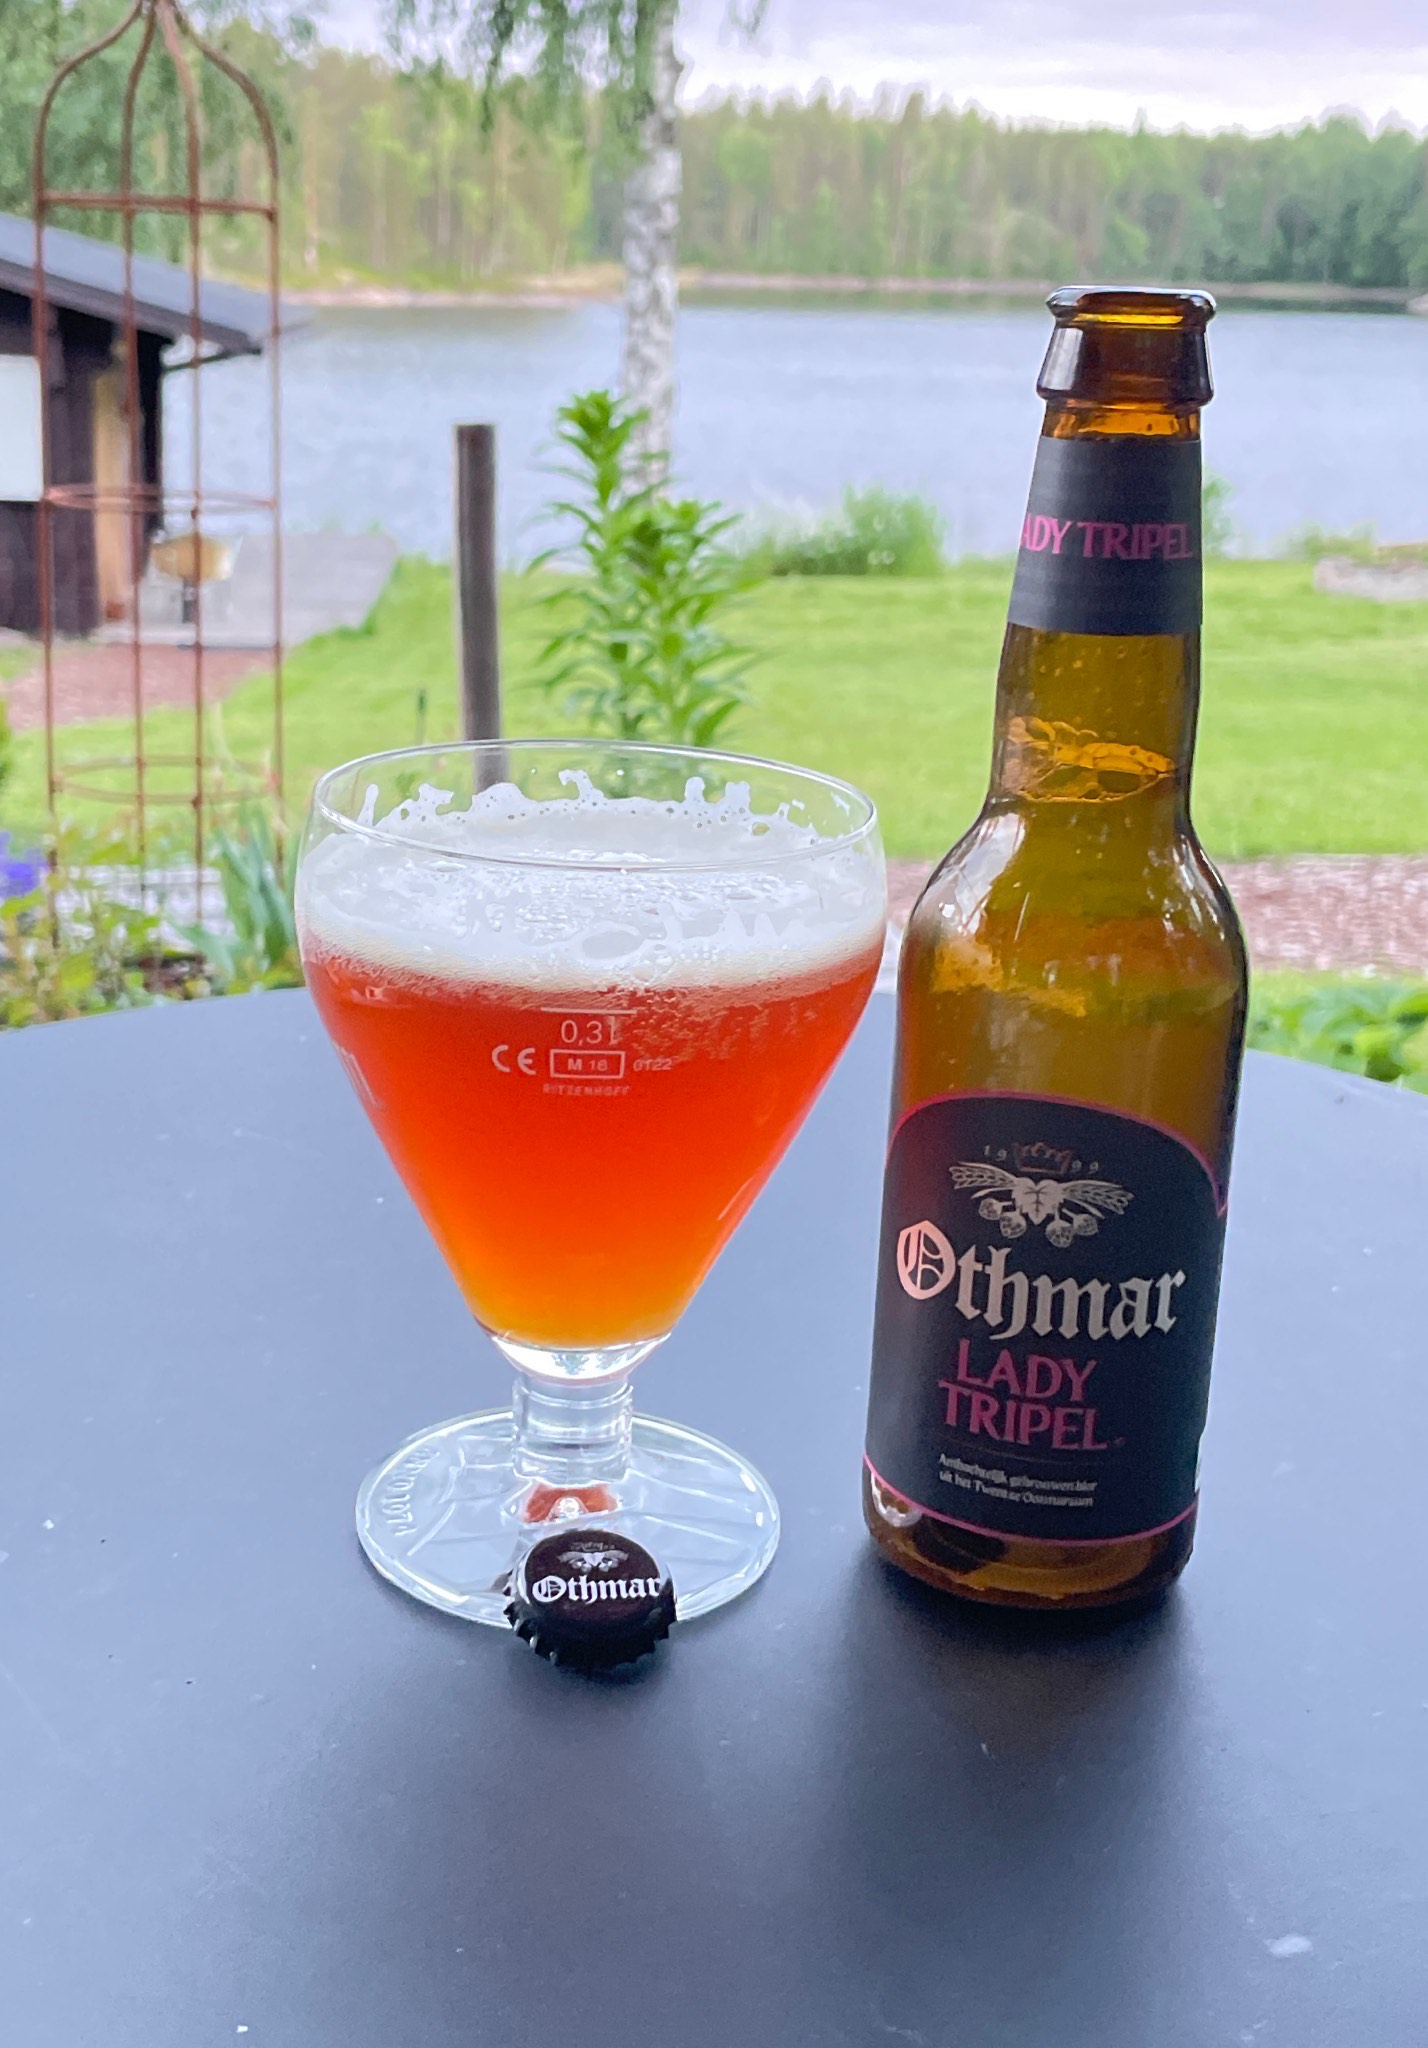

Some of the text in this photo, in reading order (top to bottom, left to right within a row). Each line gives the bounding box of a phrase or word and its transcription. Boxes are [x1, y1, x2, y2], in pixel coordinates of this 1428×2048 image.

[1077, 520, 1194, 561] TRIPEL
[567, 1058, 583, 1071] M
[896, 1219, 1187, 1341] Othmar
[956, 1336, 1098, 1402] LADY
[937, 1378, 1109, 1451] TRIPEL
[531, 1574, 662, 1605] Othmar
